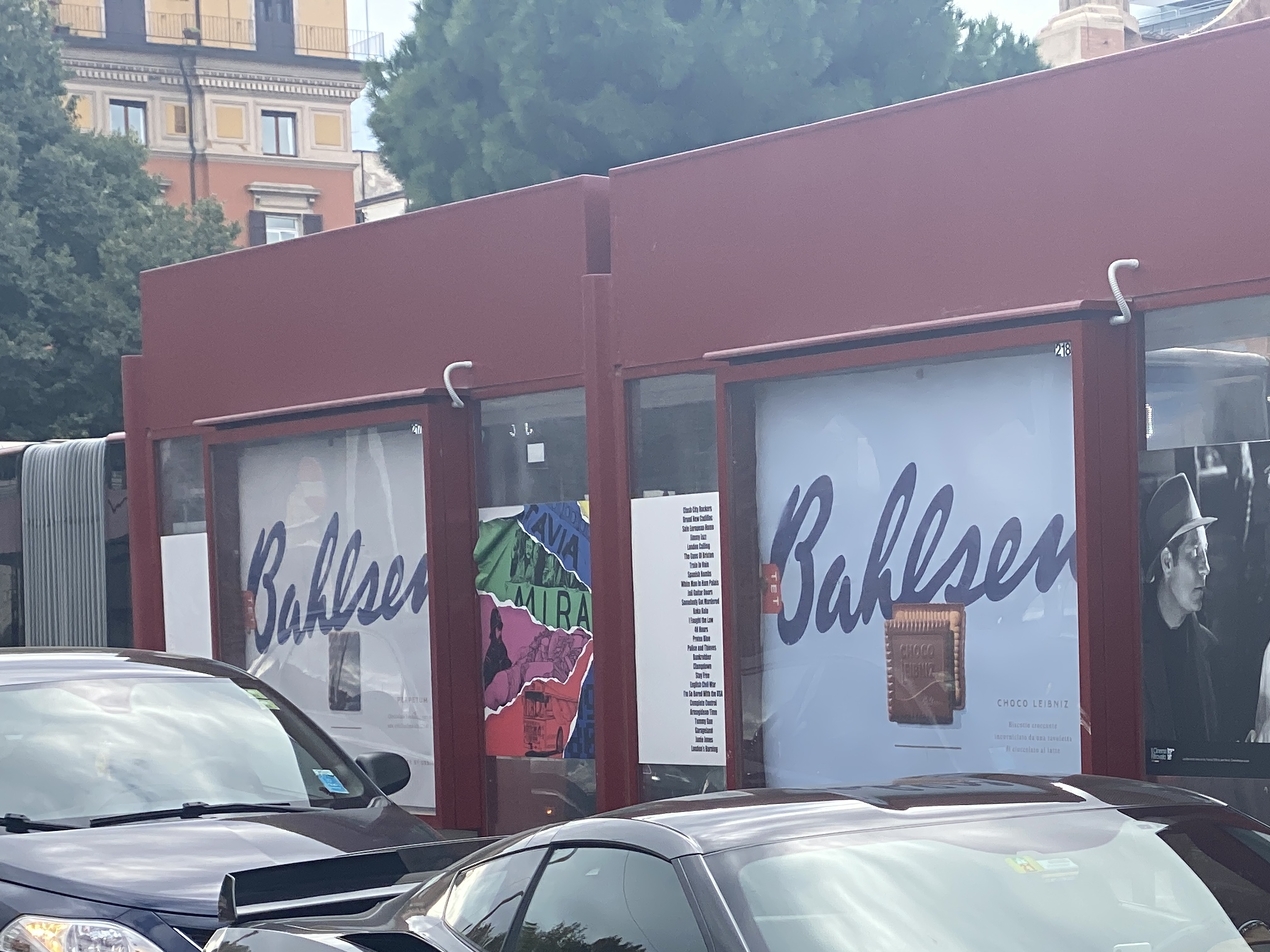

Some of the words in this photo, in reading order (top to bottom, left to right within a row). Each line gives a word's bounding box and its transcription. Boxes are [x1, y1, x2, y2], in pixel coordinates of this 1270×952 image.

[247, 512, 430, 655] Bahlsen
[769, 462, 1078, 646] Bahlsen
[997, 699, 1028, 707] CHOCO
[1033, 700, 1068, 708] LEIBNIZ
